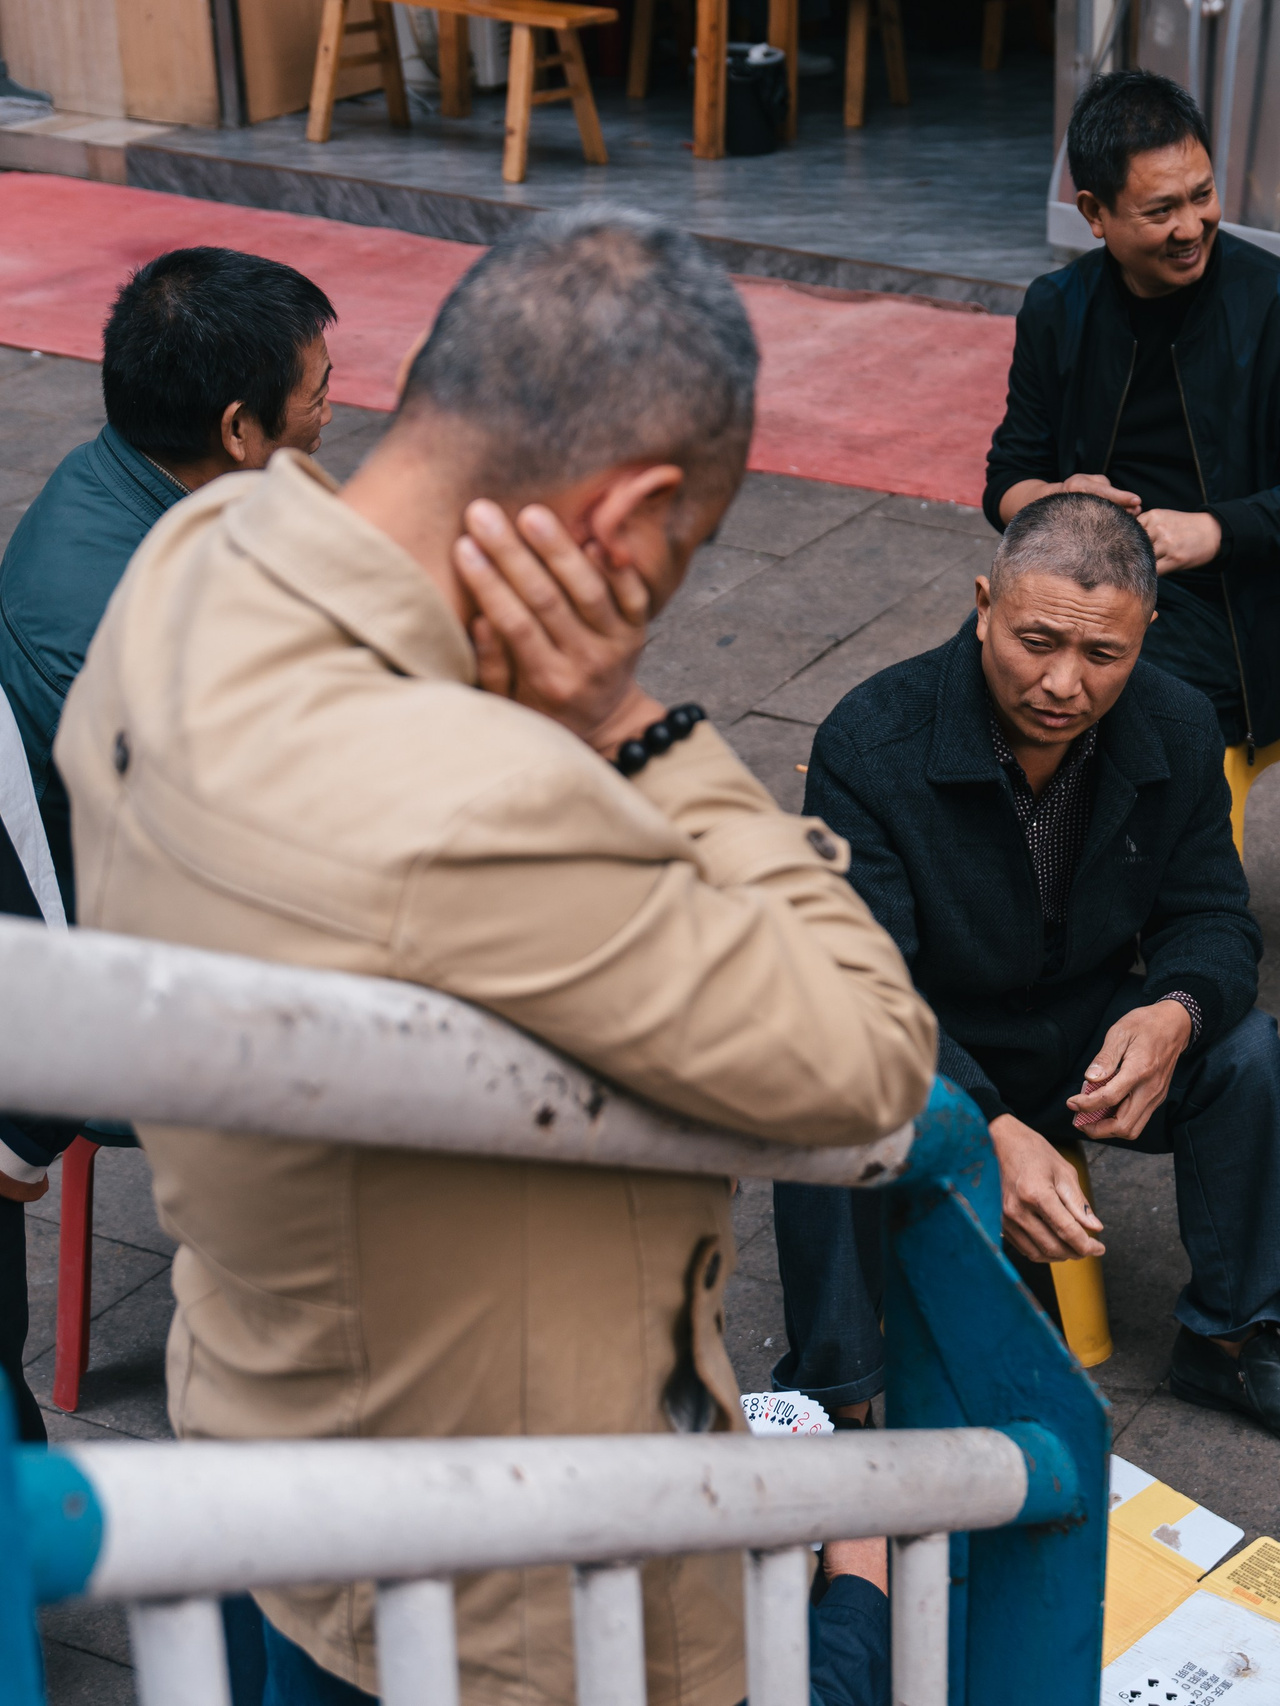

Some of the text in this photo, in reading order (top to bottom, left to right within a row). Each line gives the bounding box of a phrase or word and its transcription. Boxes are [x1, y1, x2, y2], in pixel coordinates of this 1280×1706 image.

[750, 1398, 759, 1411] 8
[782, 1403, 794, 1417] 10
[798, 1412, 809, 1426] 2
[1175, 1661, 1198, 1679] 昆明
[1187, 1667, 1209, 1684] 贵阳
[1200, 1674, 1220, 1691] 成都
[1211, 1679, 1233, 1697] 重庆
